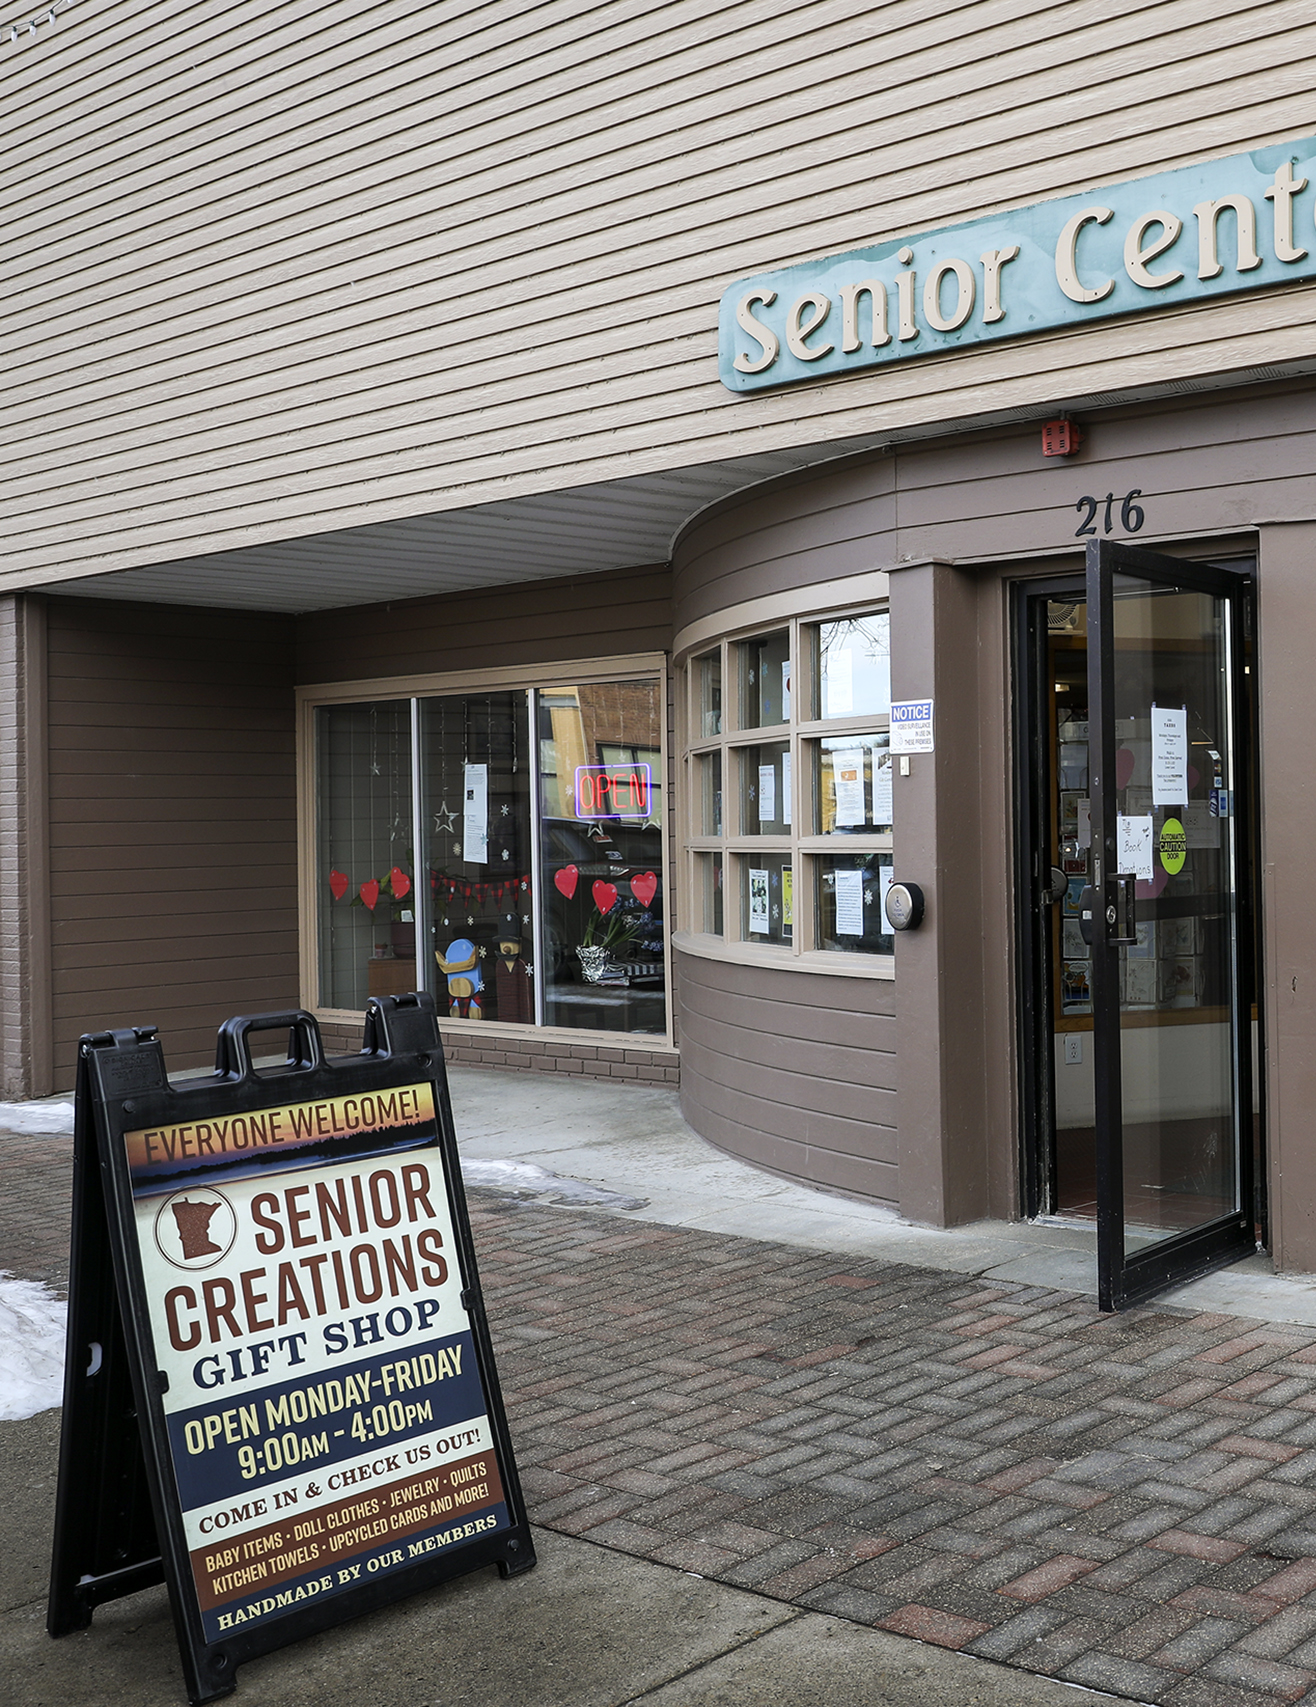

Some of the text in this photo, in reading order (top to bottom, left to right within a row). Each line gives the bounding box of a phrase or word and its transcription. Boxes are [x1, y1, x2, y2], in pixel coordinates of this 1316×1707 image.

[731, 245, 1021, 374] Senior
[1075, 489, 1145, 537] 216
[893, 705, 929, 721] NOTICE
[580, 773, 647, 809] OPEN
[1123, 839, 1142, 853] Book
[1160, 833, 1186, 841] AUTOMATIC
[1160, 842, 1186, 851] CAUTION
[143, 1089, 420, 1167] EVERYONE WELCOME!
[251, 1164, 437, 1255] SENIOR
[164, 1229, 449, 1351] CREATIONS
[192, 1298, 441, 1390] GIFT SHOP
[183, 1344, 464, 1456] OPEN MONDAY-FRIDAY
[236, 1430, 331, 1480] 9:00AM
[350, 1399, 434, 1443] 4:00PM
[198, 1428, 481, 1535] COME IN & CHECK US OUT!
[205, 1461, 487, 1573] BABY ITEMS DOLL CLOTHES JEWELRY QUILTS
[212, 1482, 490, 1595] KITCHEN TOWELS UPCYCLED CARDS AND MORE!
[217, 1513, 498, 1630] HANDMADE BY OUR MEMBERS
